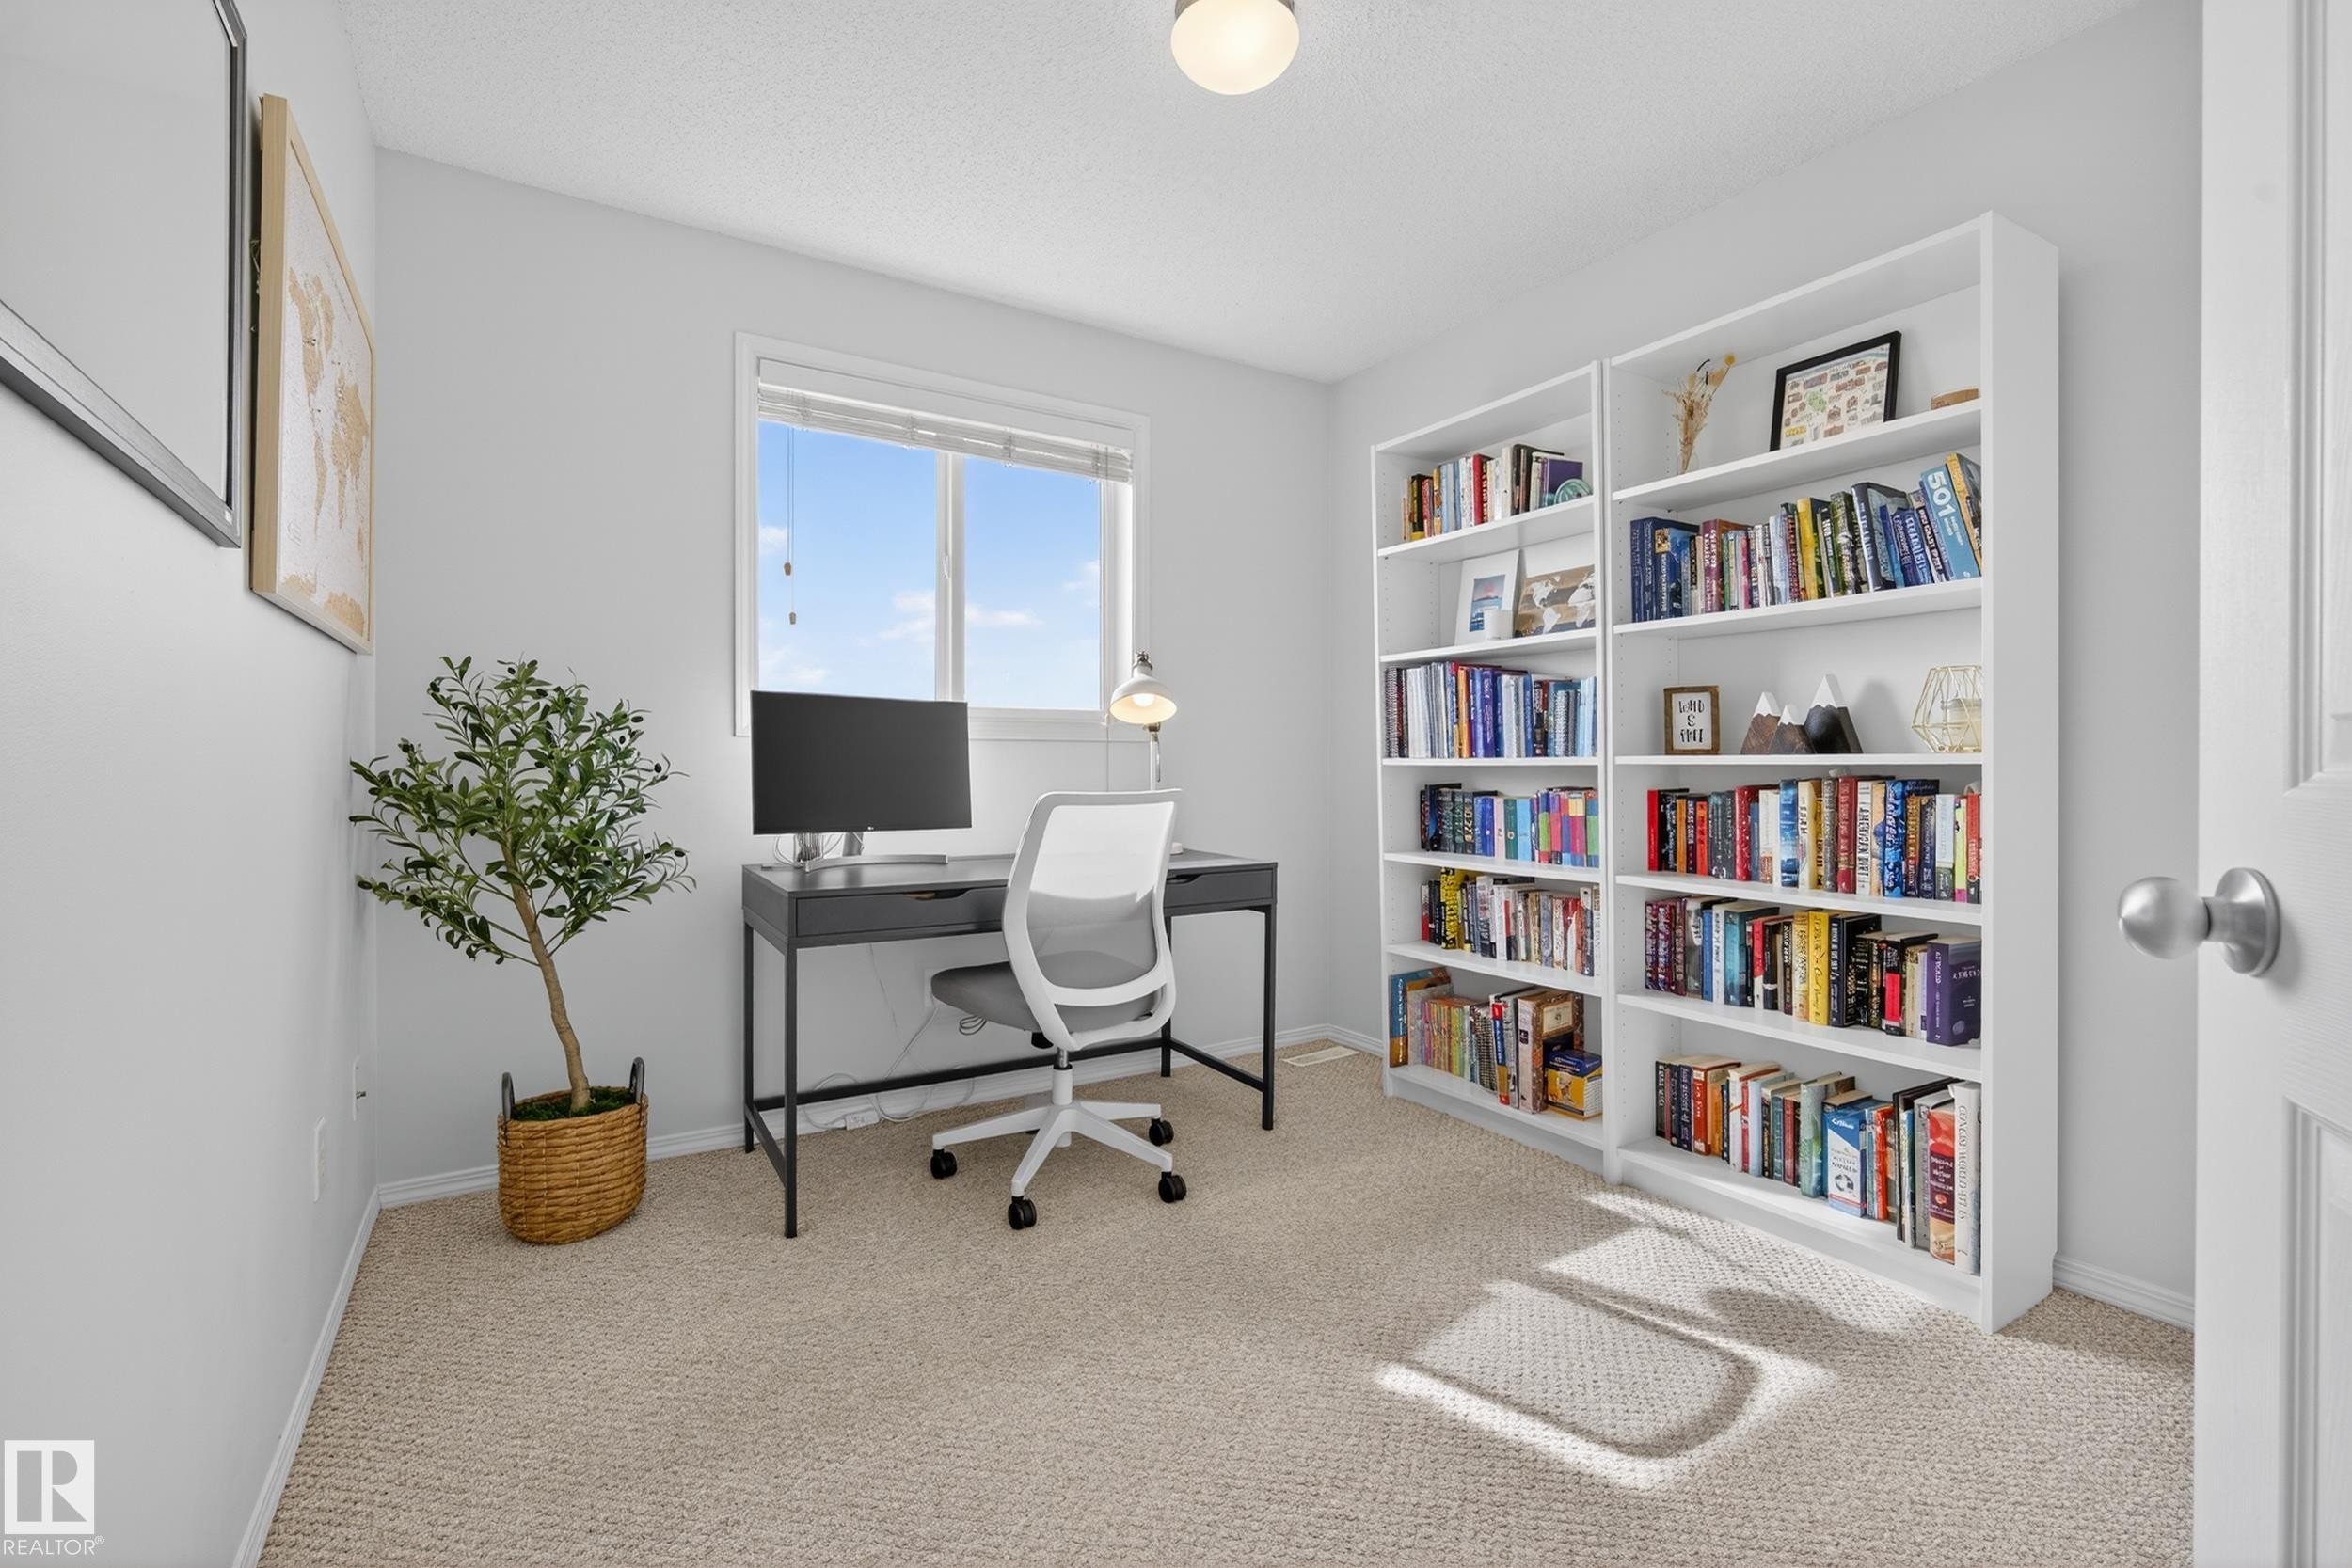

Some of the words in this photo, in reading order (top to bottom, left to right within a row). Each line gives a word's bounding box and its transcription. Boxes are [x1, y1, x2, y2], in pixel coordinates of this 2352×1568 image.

[1927, 470, 1956, 517] 501
[1857, 807, 1870, 854] AMERICAN
[1857, 856, 1870, 878] DIRT
